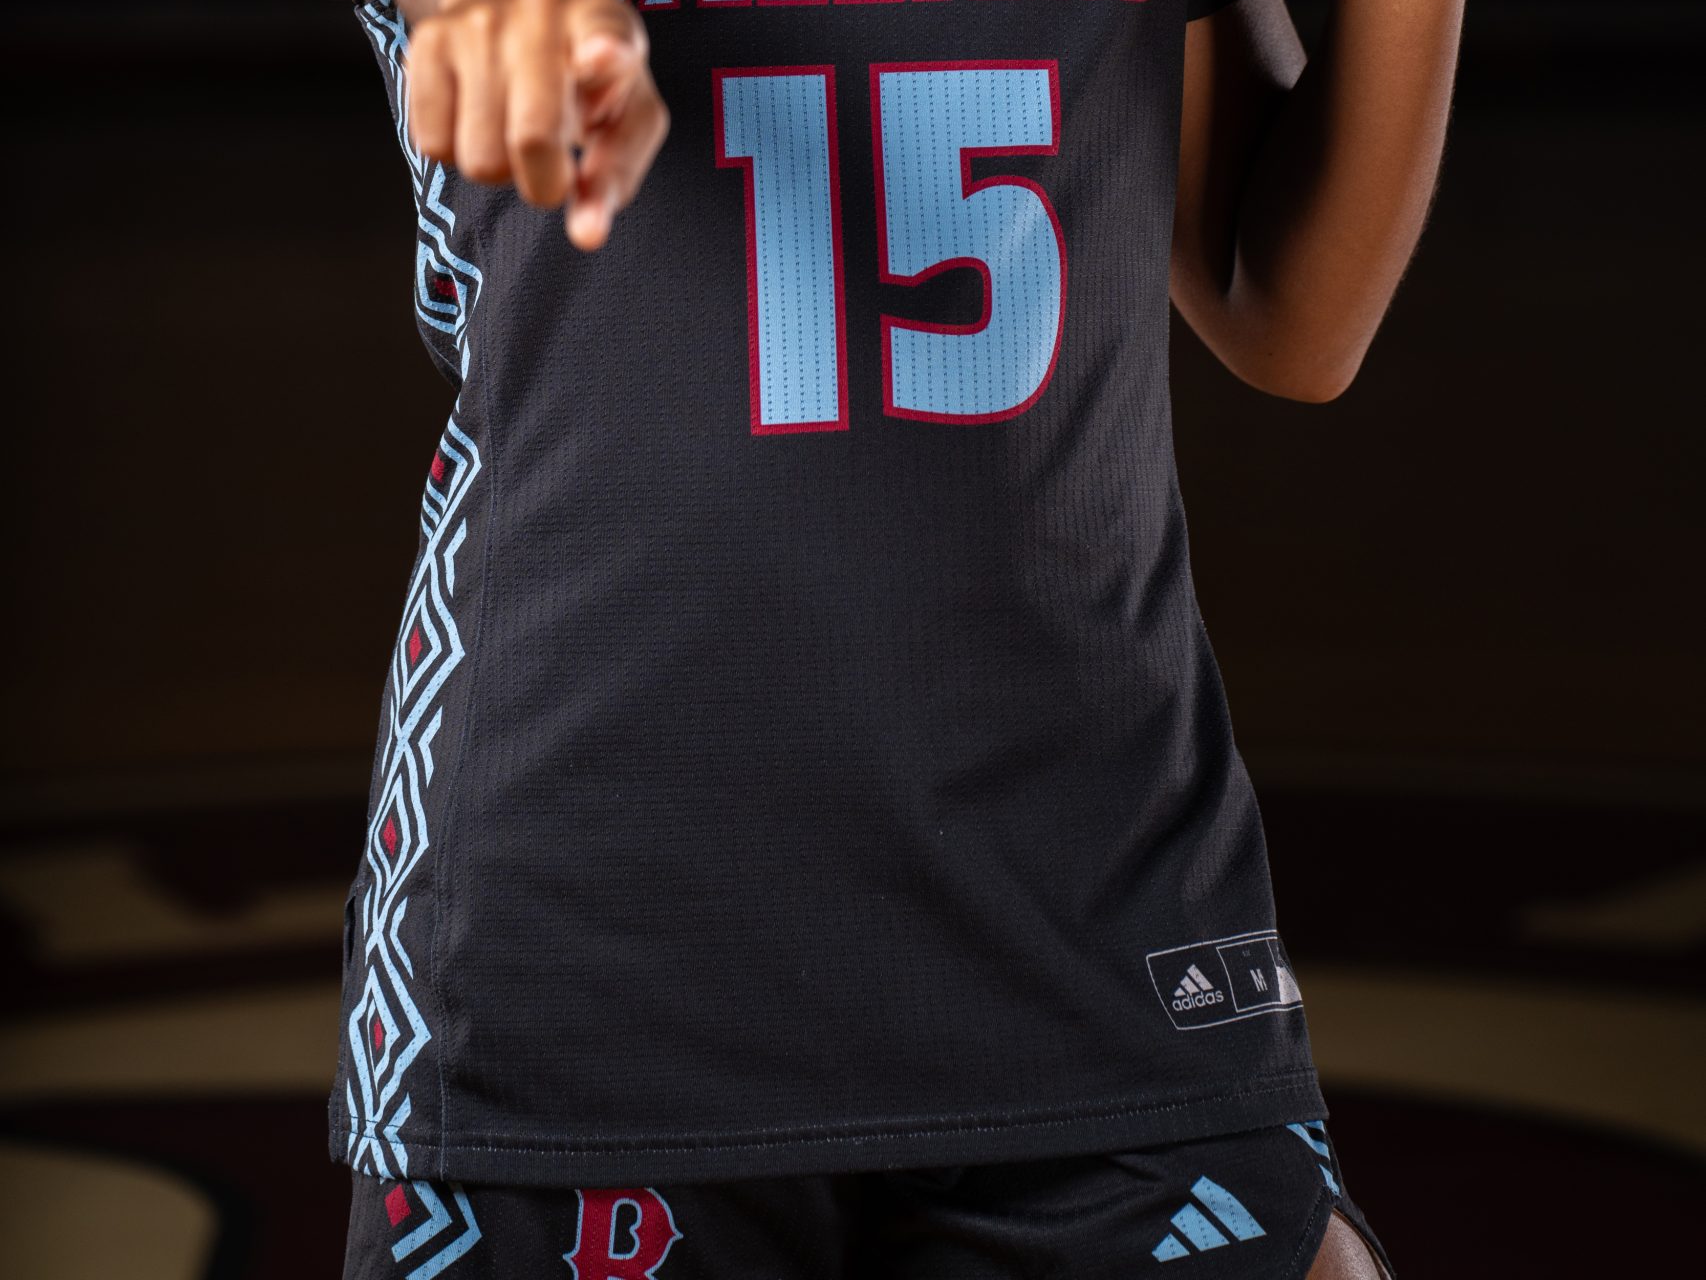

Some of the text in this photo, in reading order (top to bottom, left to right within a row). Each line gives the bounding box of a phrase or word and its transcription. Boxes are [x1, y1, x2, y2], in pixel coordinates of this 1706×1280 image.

[712, 60, 1068, 436] 15
[1250, 968, 1268, 992] M
[1172, 989, 1225, 1012] adidas
